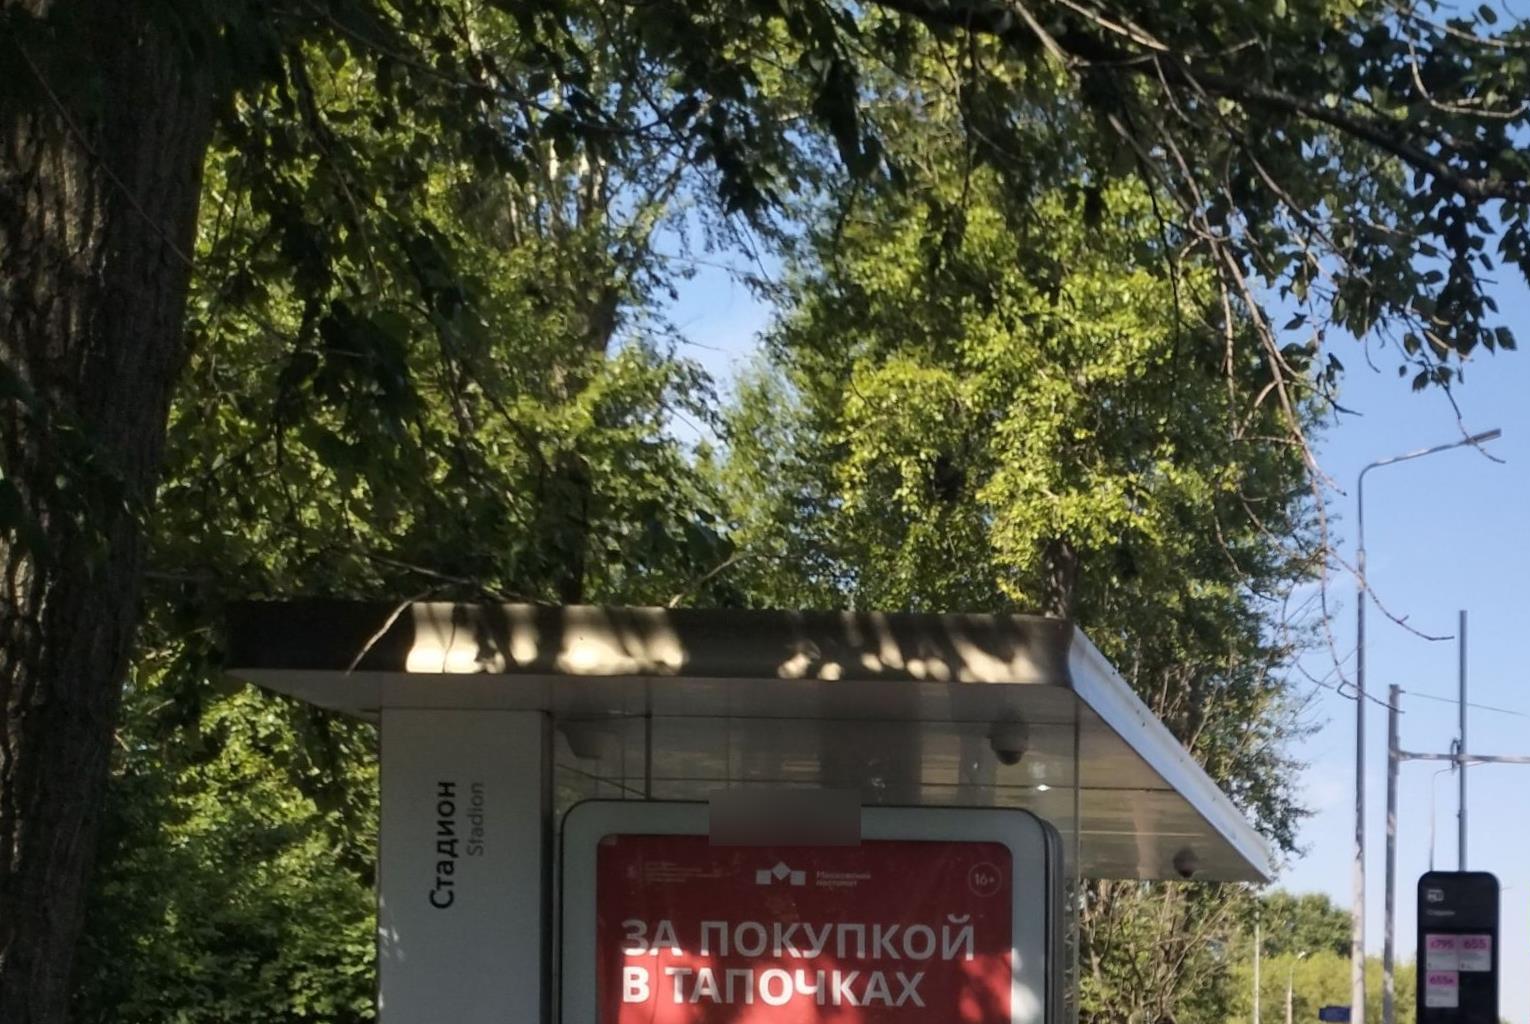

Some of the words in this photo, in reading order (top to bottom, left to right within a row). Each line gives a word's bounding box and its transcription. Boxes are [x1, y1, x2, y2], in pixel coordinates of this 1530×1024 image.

[466, 782, 484, 857] Stadion
[429, 781, 459, 909] Стадион
[974, 872, 995, 887] 16+
[620, 919, 682, 956] ЗА
[700, 913, 975, 961] ПОКУПКОЙ
[622, 967, 650, 1003] В
[666, 967, 926, 1007] ТАПОЧКАХ
